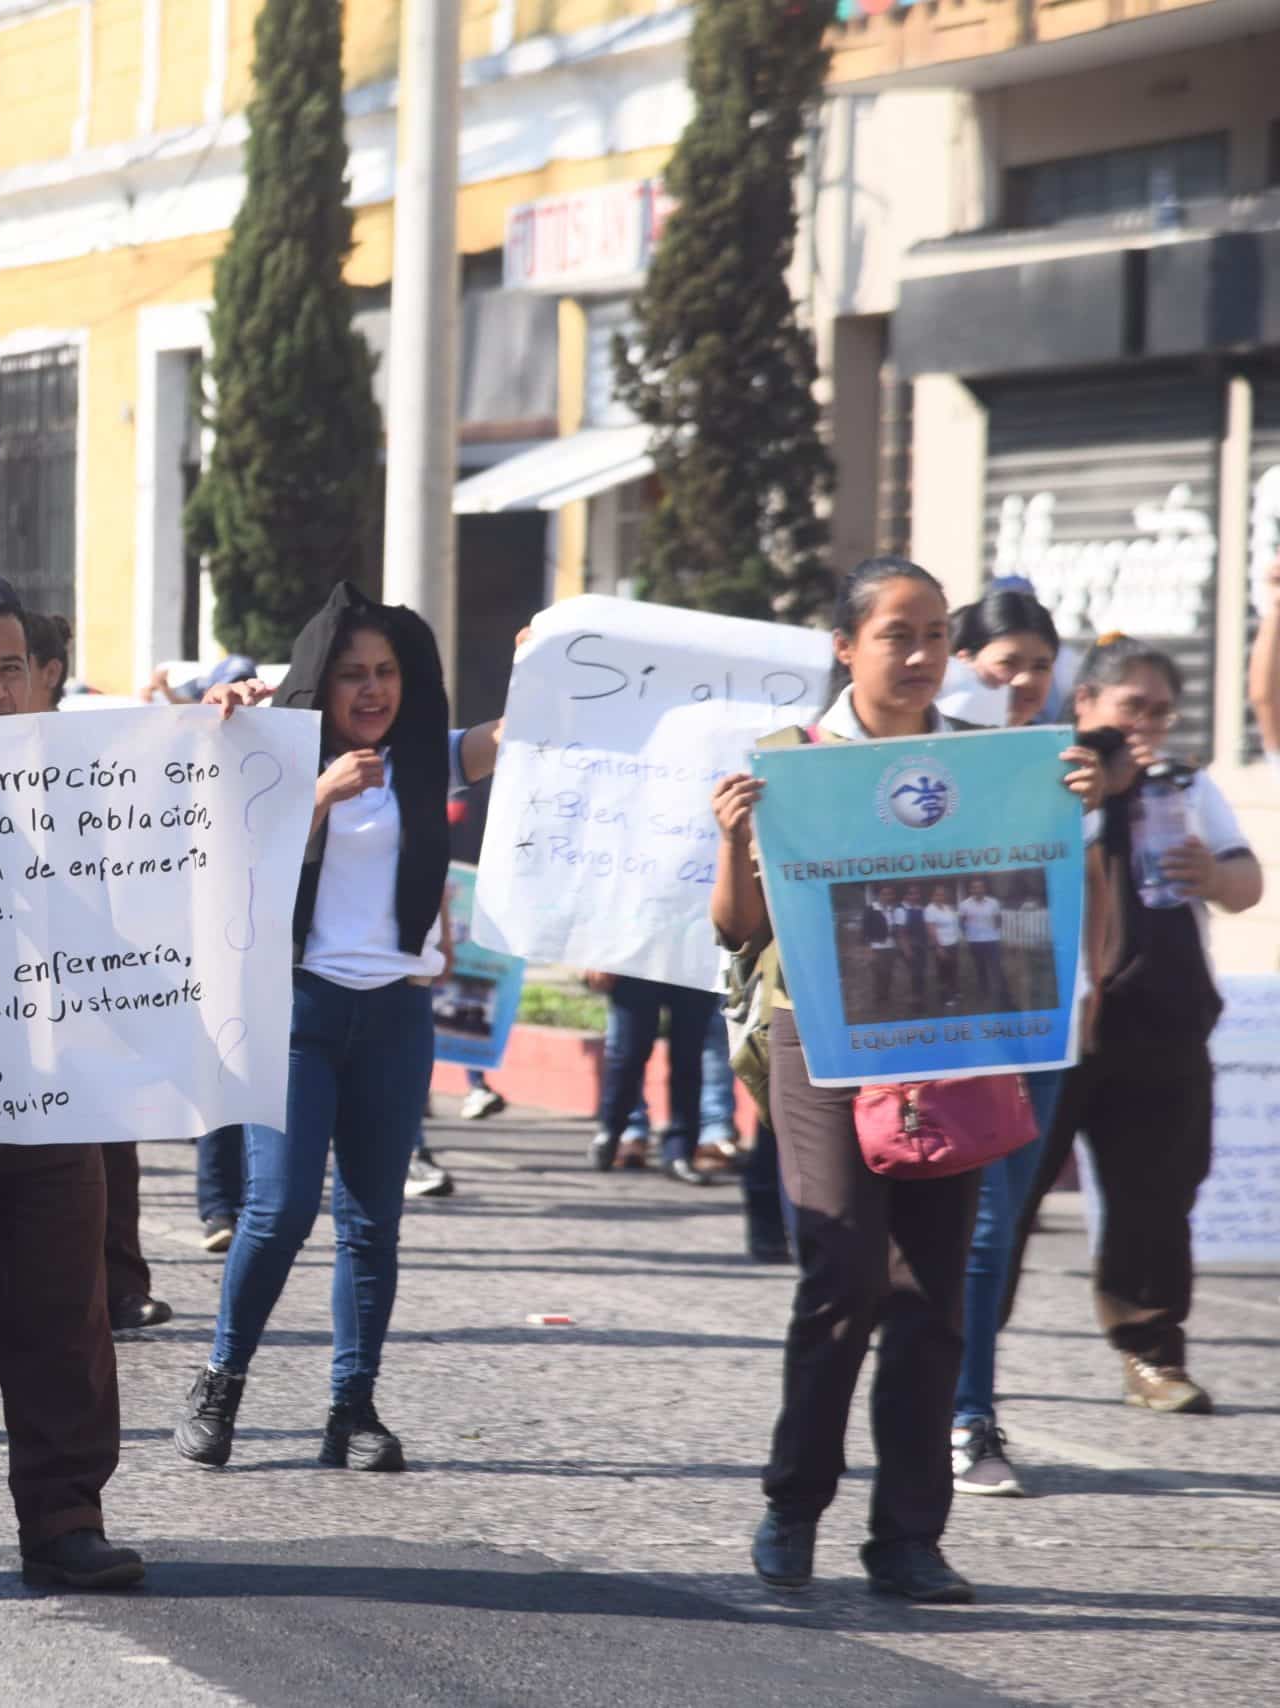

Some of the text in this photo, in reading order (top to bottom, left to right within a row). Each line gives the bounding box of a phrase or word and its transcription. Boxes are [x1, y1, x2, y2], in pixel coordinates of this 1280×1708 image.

[690, 671, 732, 702] al
[31, 806, 56, 833] la
[24, 855, 56, 881] de
[780, 852, 915, 882] TERRITORIO
[921, 845, 1001, 872] NUEVO
[47, 978, 202, 1024] justamente
[847, 1014, 1053, 1051] EQUIPO DE SALUD
